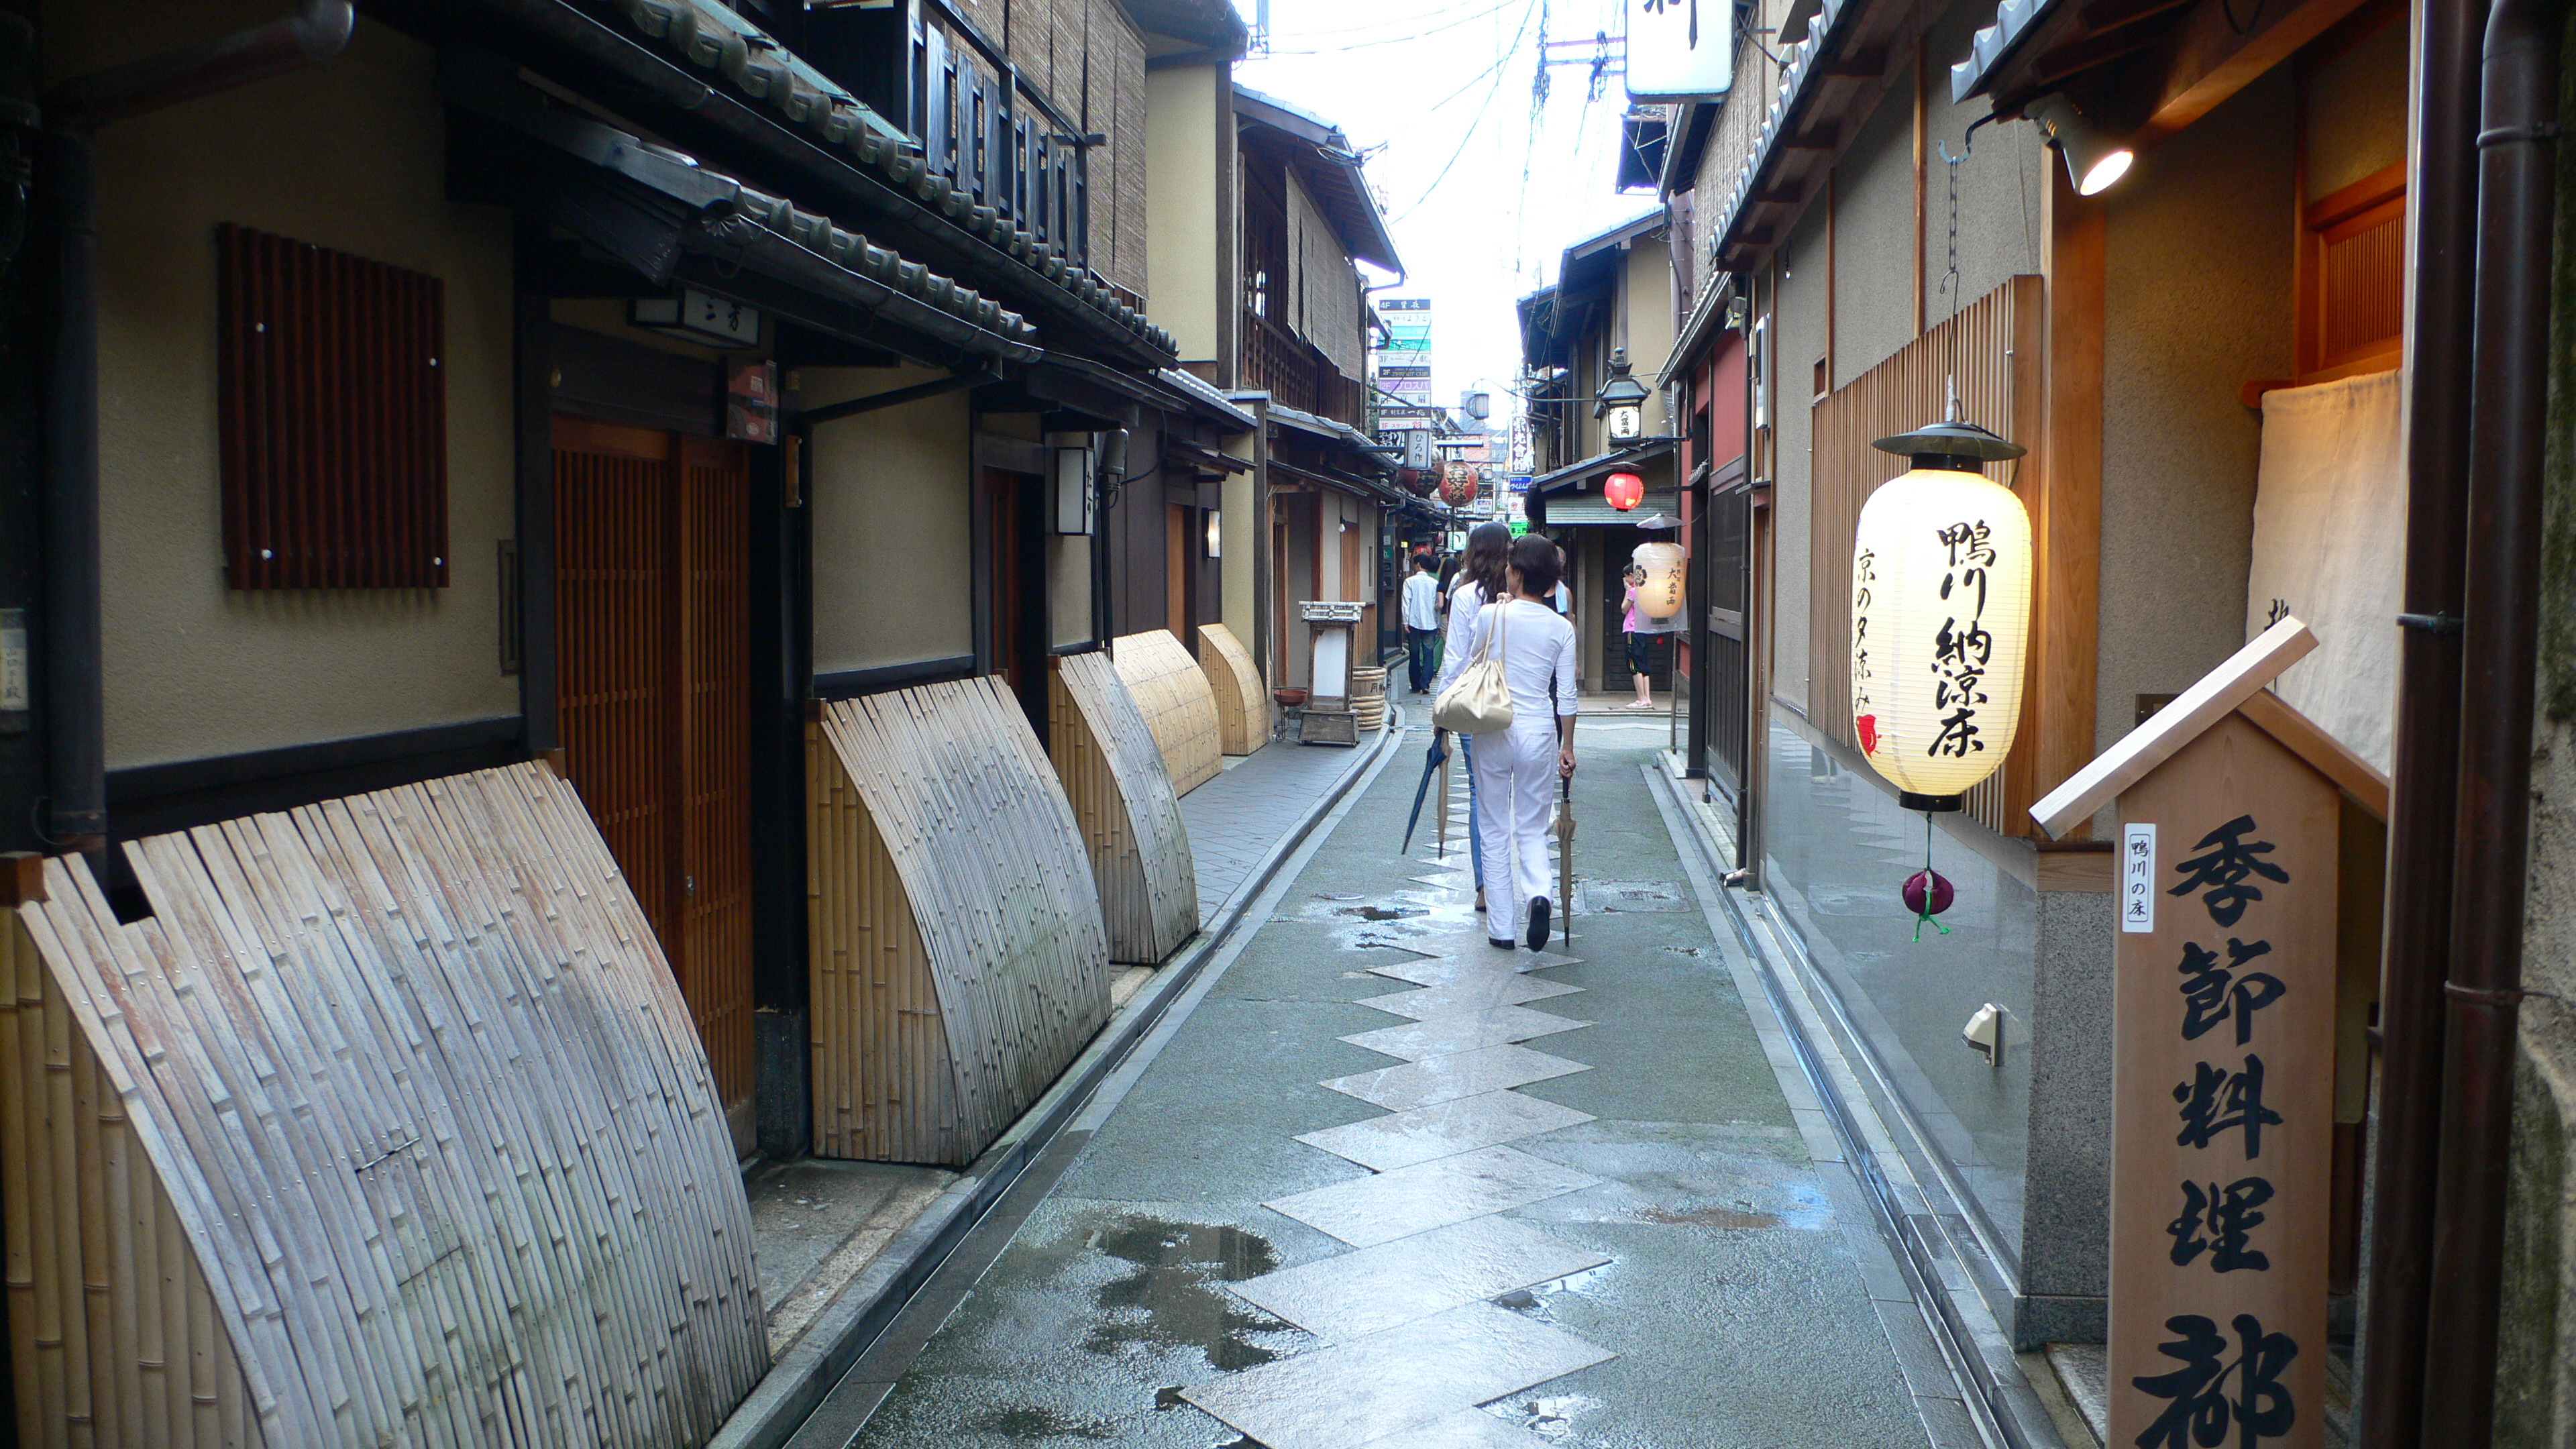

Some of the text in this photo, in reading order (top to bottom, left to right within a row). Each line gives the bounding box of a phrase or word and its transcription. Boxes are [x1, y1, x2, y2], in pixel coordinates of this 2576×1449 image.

[1380, 301, 1391, 309] 4F
[1395, 381, 1428, 390] プロスパ
[1415, 434, 1424, 463] ひろ作
[1855, 547, 1876, 714] 京の夕涼み
[1928, 519, 1996, 759] 鴨川納涼床
[2129, 840, 2149, 916] 鴨川の床
